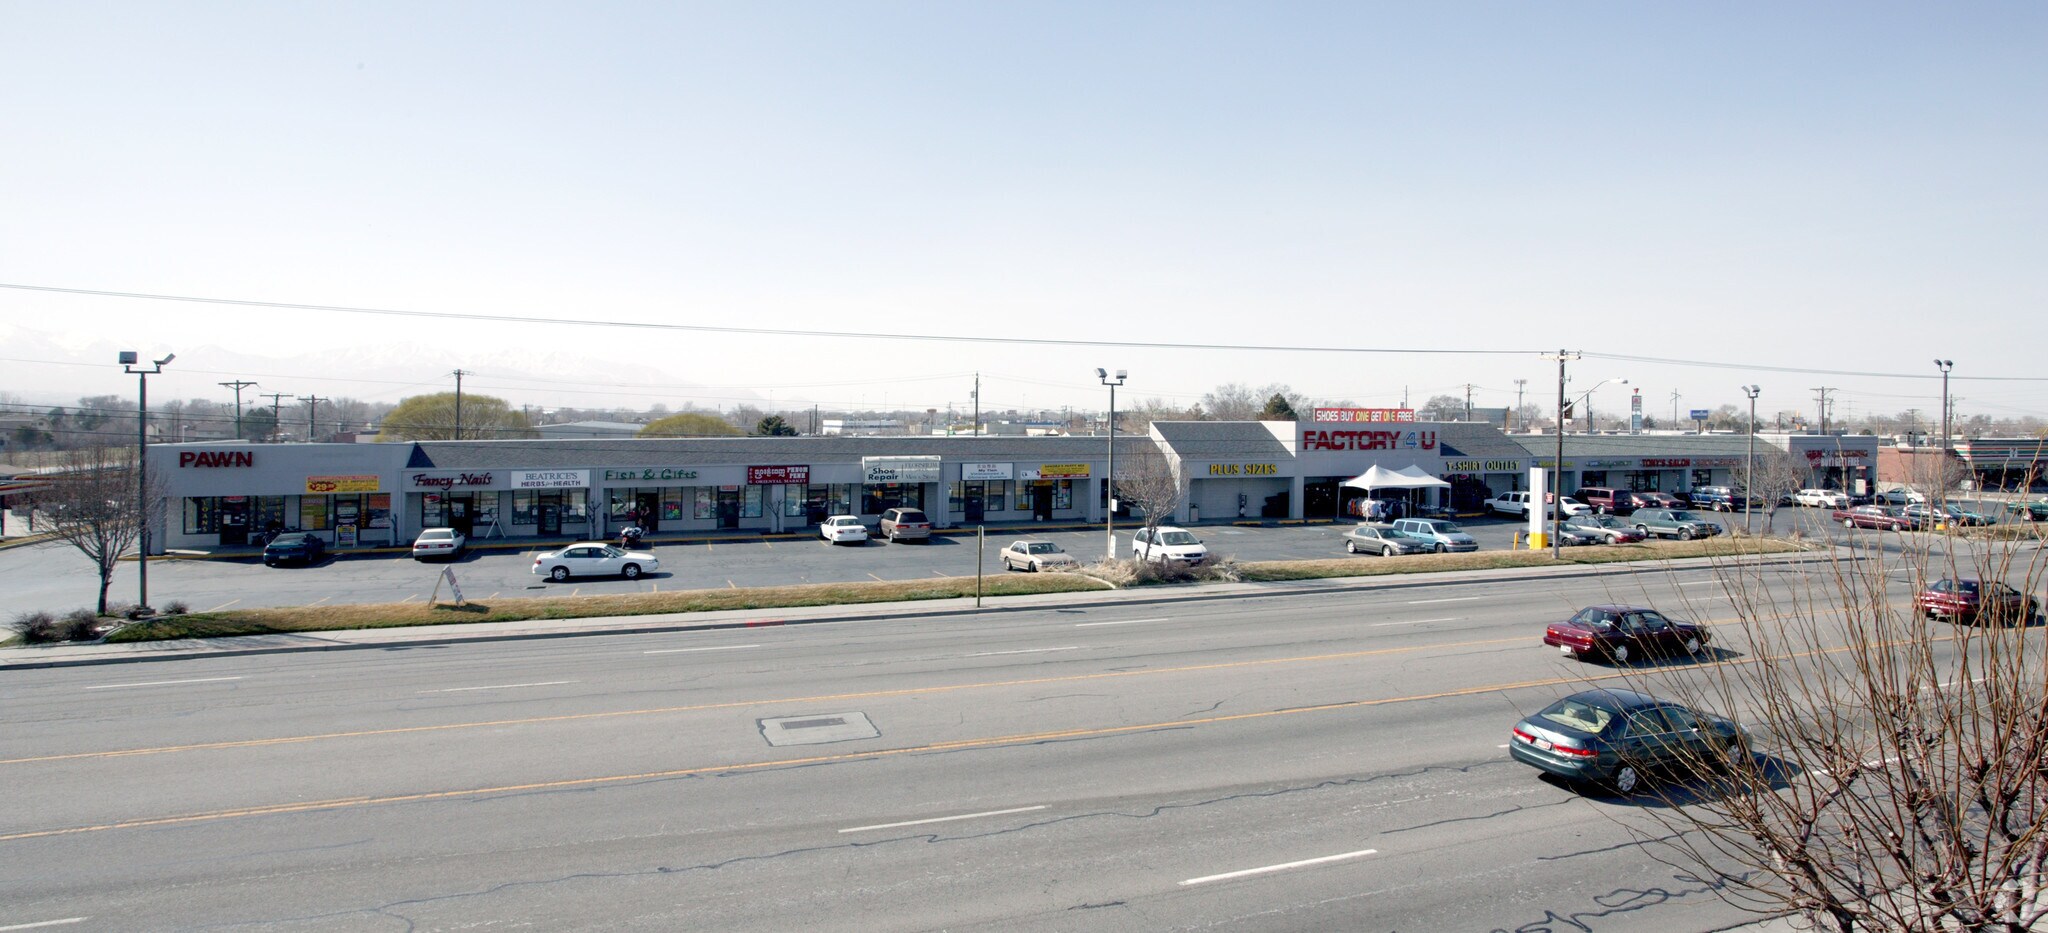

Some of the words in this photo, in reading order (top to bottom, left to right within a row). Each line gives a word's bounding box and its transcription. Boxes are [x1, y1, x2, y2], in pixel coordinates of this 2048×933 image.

[1316, 411, 1339, 421] SHOES
[1341, 411, 1354, 421] BUY
[1356, 411, 1369, 421] ONE
[1371, 411, 1382, 421] GET
[1384, 411, 1396, 421] ONE
[1397, 411, 1413, 421] FREE
[1303, 431, 1401, 450] FACTORY
[1405, 432, 1417, 448] 4
[1421, 431, 1435, 450] U
[180, 451, 253, 468] PAWN
[1668, 458, 1690, 466] SALON
[1210, 464, 1240, 475] PLUS
[1244, 464, 1277, 475] SIZES
[1446, 461, 1482, 471] T-SHIRT
[1486, 460, 1520, 471] OUTLET
[605, 470, 636, 480] Fish
[643, 468, 656, 480] &
[661, 468, 697, 480] Gifts
[868, 474, 899, 482] Repair
[412, 474, 454, 491] Fancy
[458, 472, 492, 486] Nails
